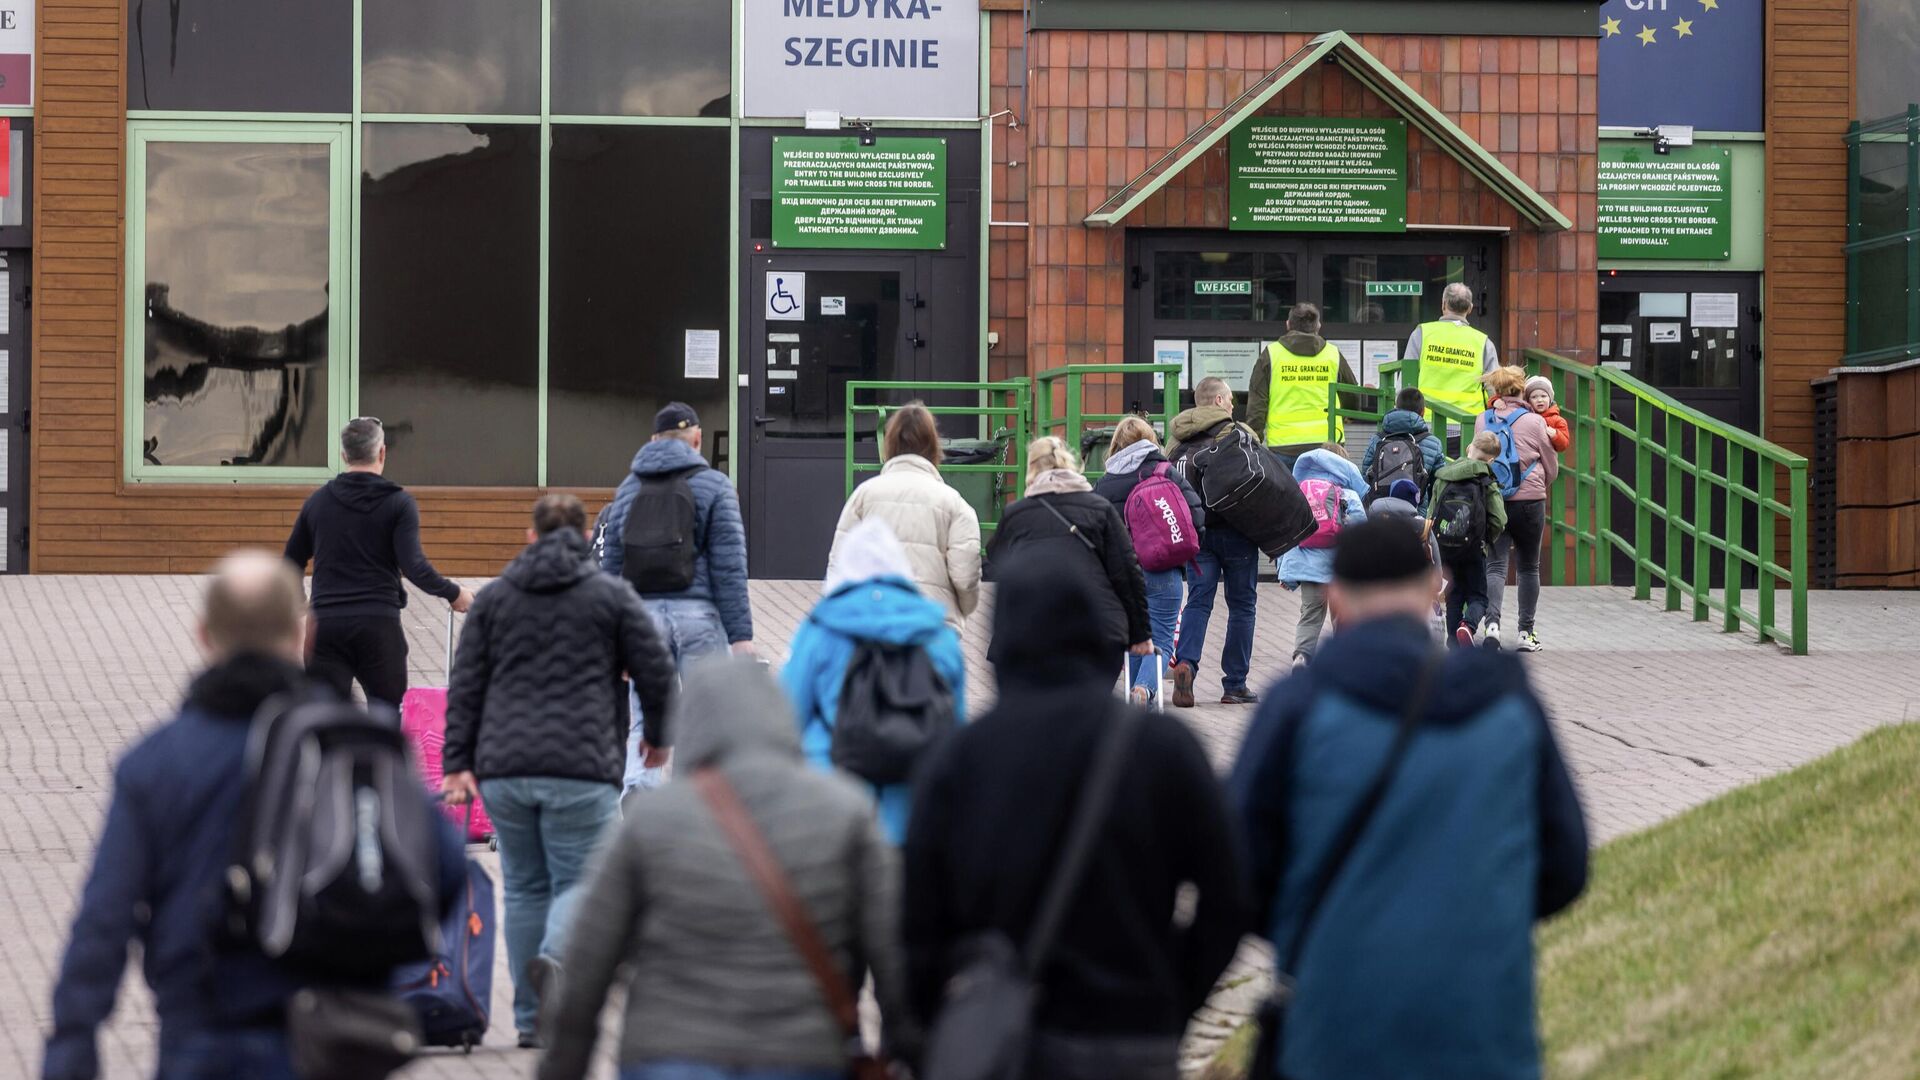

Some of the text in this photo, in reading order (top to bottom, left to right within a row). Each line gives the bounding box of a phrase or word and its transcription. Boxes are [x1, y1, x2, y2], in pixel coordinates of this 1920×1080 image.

[783, 0, 941, 19] MEDYKA-
[785, 37, 939, 68] SZEGINIE
[860, 152, 900, 160] WYŁĄCZNIE
[917, 152, 935, 160] OSÓB
[784, 161, 854, 169] PRZEKRACZAJĄCYCH
[888, 161, 934, 170] PAŃSTWOWĄ.
[1674, 173, 1719, 182] PAŃSTWOWĄ.
[1154, 497, 1183, 544] Reebok
